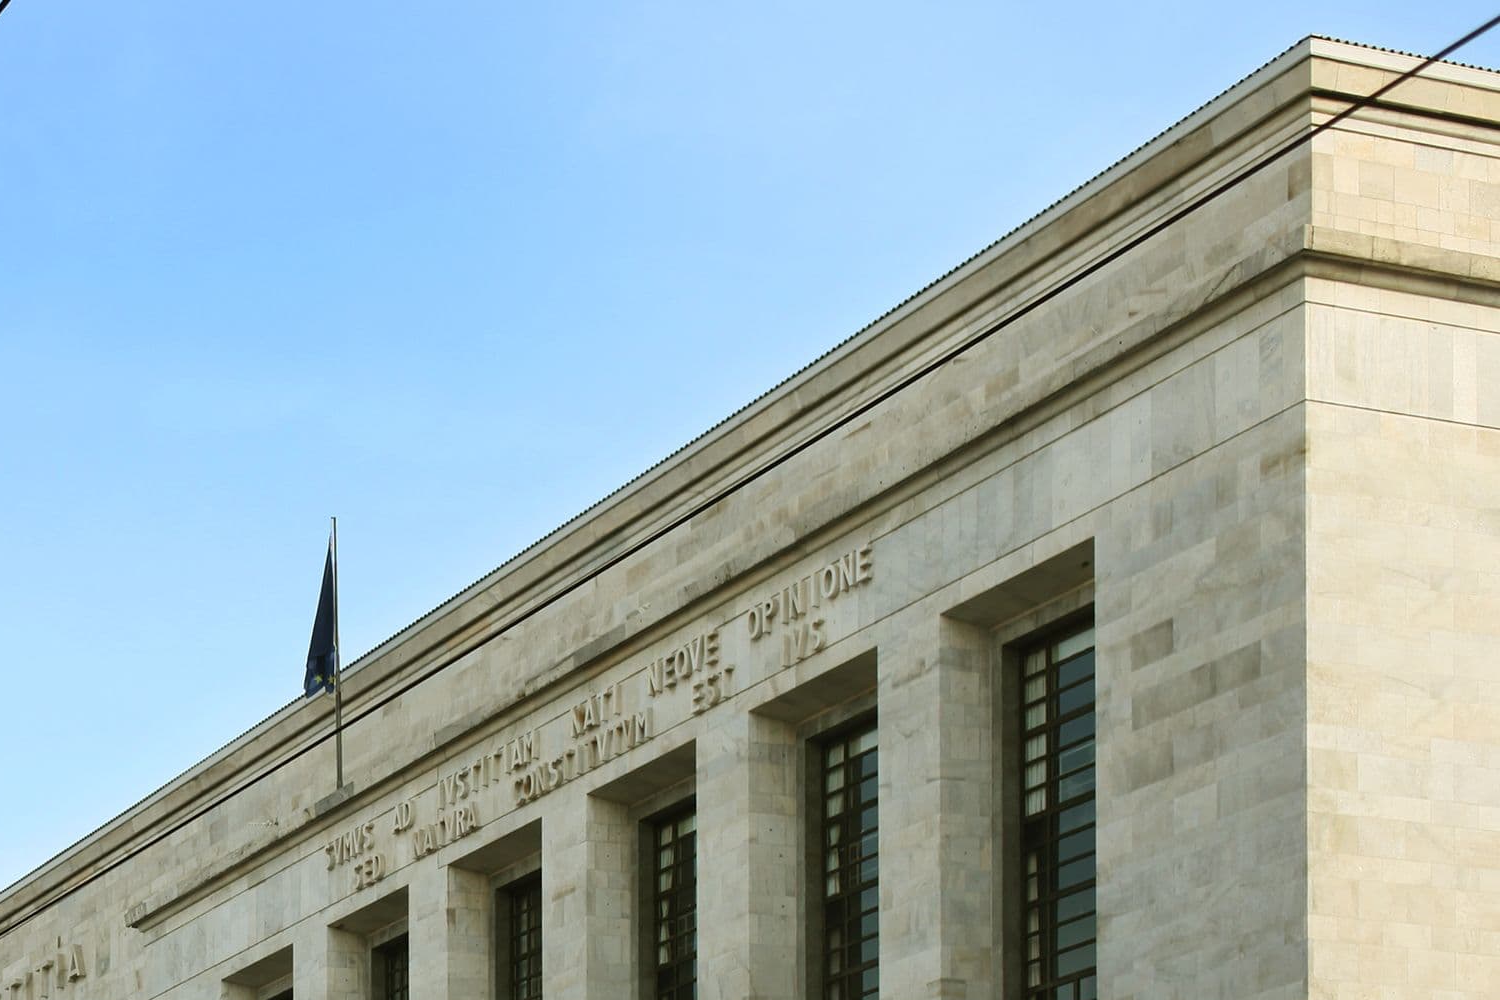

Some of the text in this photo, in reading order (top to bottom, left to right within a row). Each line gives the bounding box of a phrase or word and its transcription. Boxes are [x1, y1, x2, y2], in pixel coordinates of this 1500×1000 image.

[325, 822, 375, 871] SVMVS
[393, 800, 416, 835] AD
[572, 683, 623, 739] NATI
[647, 632, 719, 697] NEQVE
[748, 544, 873, 641] OPINIONE
[354, 853, 386, 890] SED
[412, 801, 484, 861] NATVRA
[692, 664, 735, 716] EST
[780, 618, 826, 668] IVS
